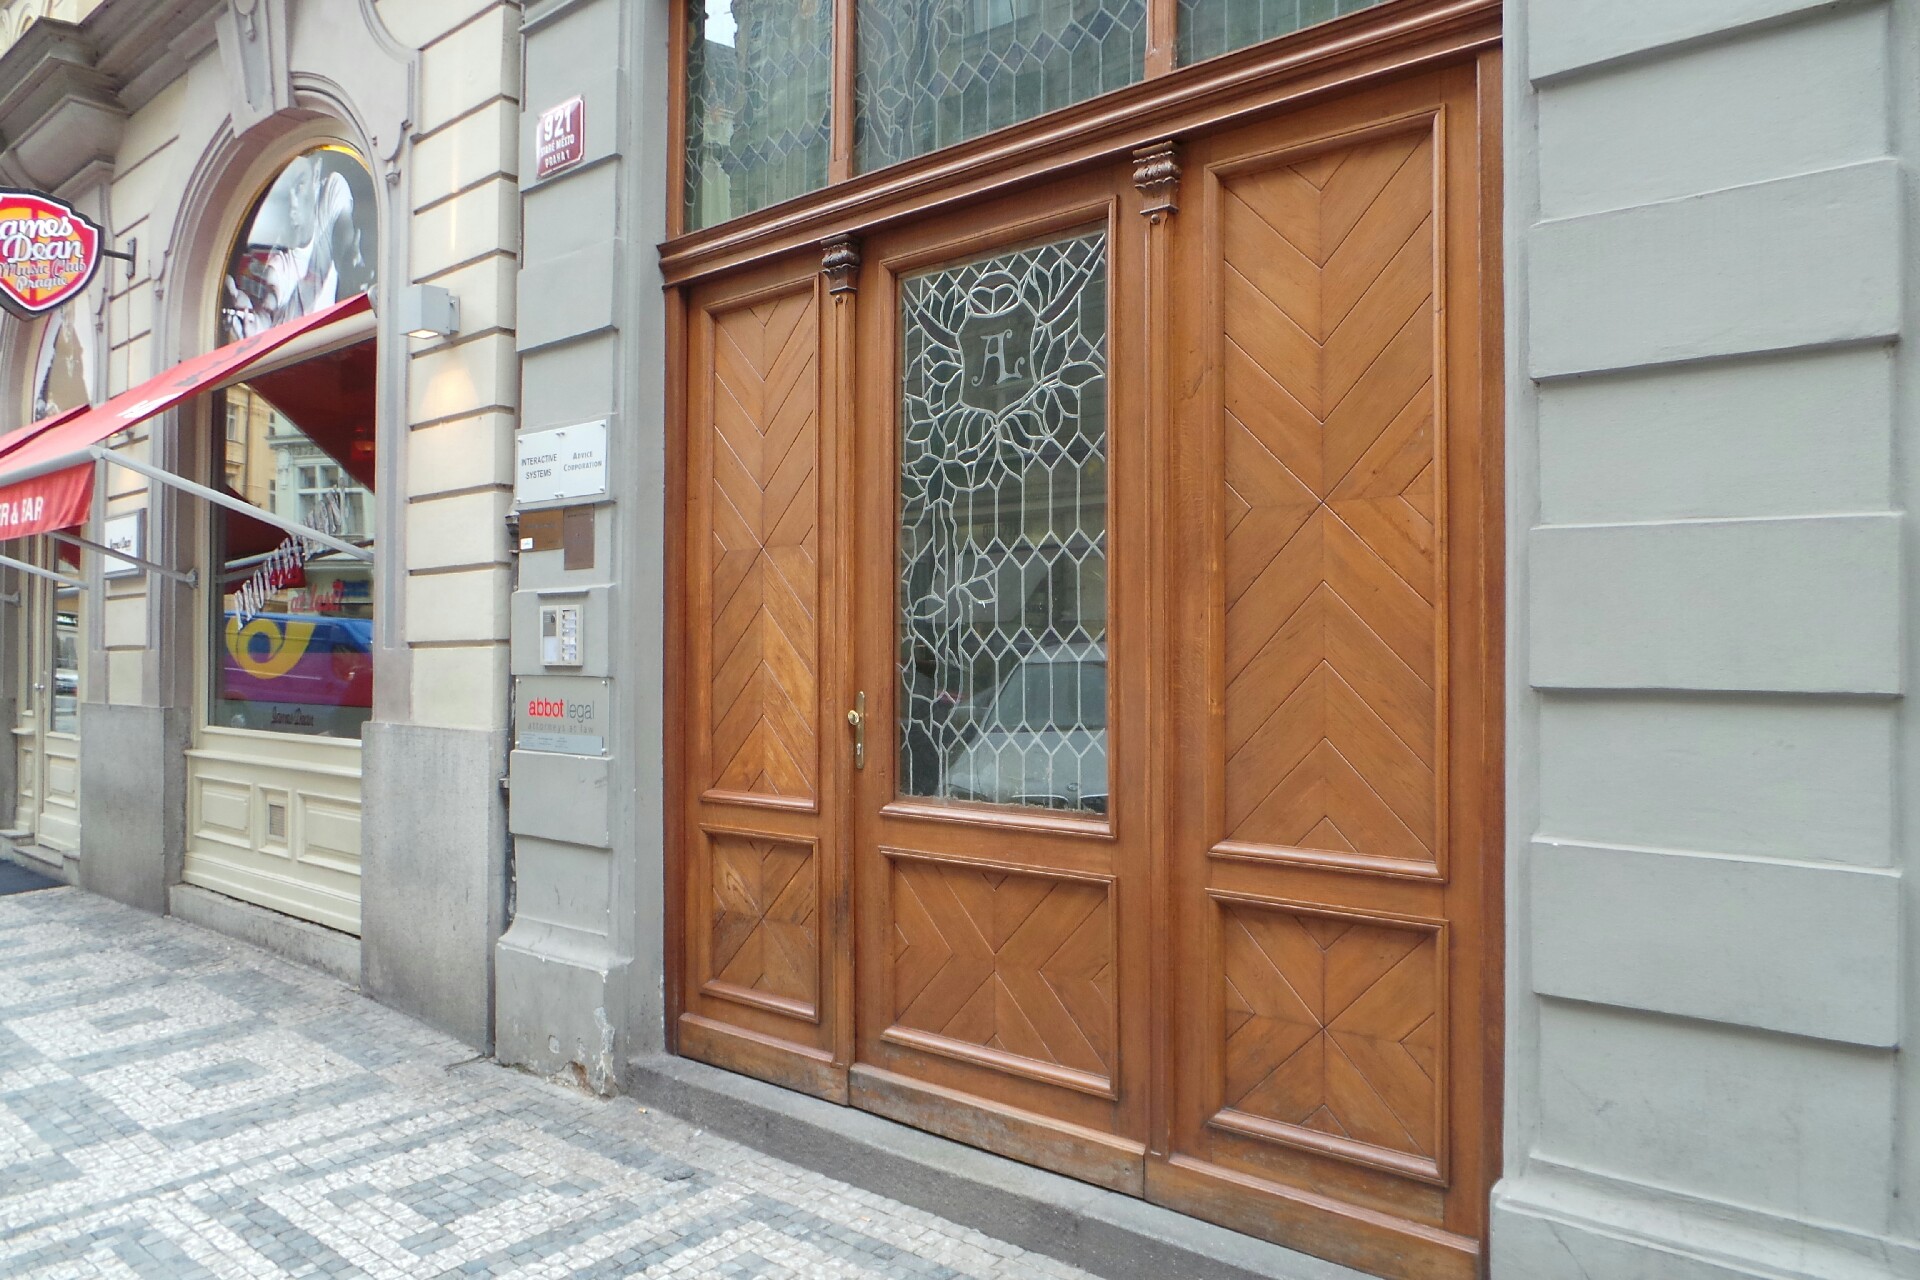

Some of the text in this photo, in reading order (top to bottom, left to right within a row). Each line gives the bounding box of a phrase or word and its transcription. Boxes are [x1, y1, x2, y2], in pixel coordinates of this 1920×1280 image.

[544, 106, 571, 141] 921
[544, 151, 566, 168] PRAHA
[0, 216, 74, 240] ames
[2, 232, 84, 264] Dean
[0, 258, 87, 277] Music Club
[16, 275, 68, 292] Prague
[521, 453, 558, 467] INTERACTIVE
[525, 469, 552, 480] SYSTEMS
[10, 501, 19, 526] &
[528, 697, 595, 723] abbot legal
[527, 722, 594, 734] attorneys at law
